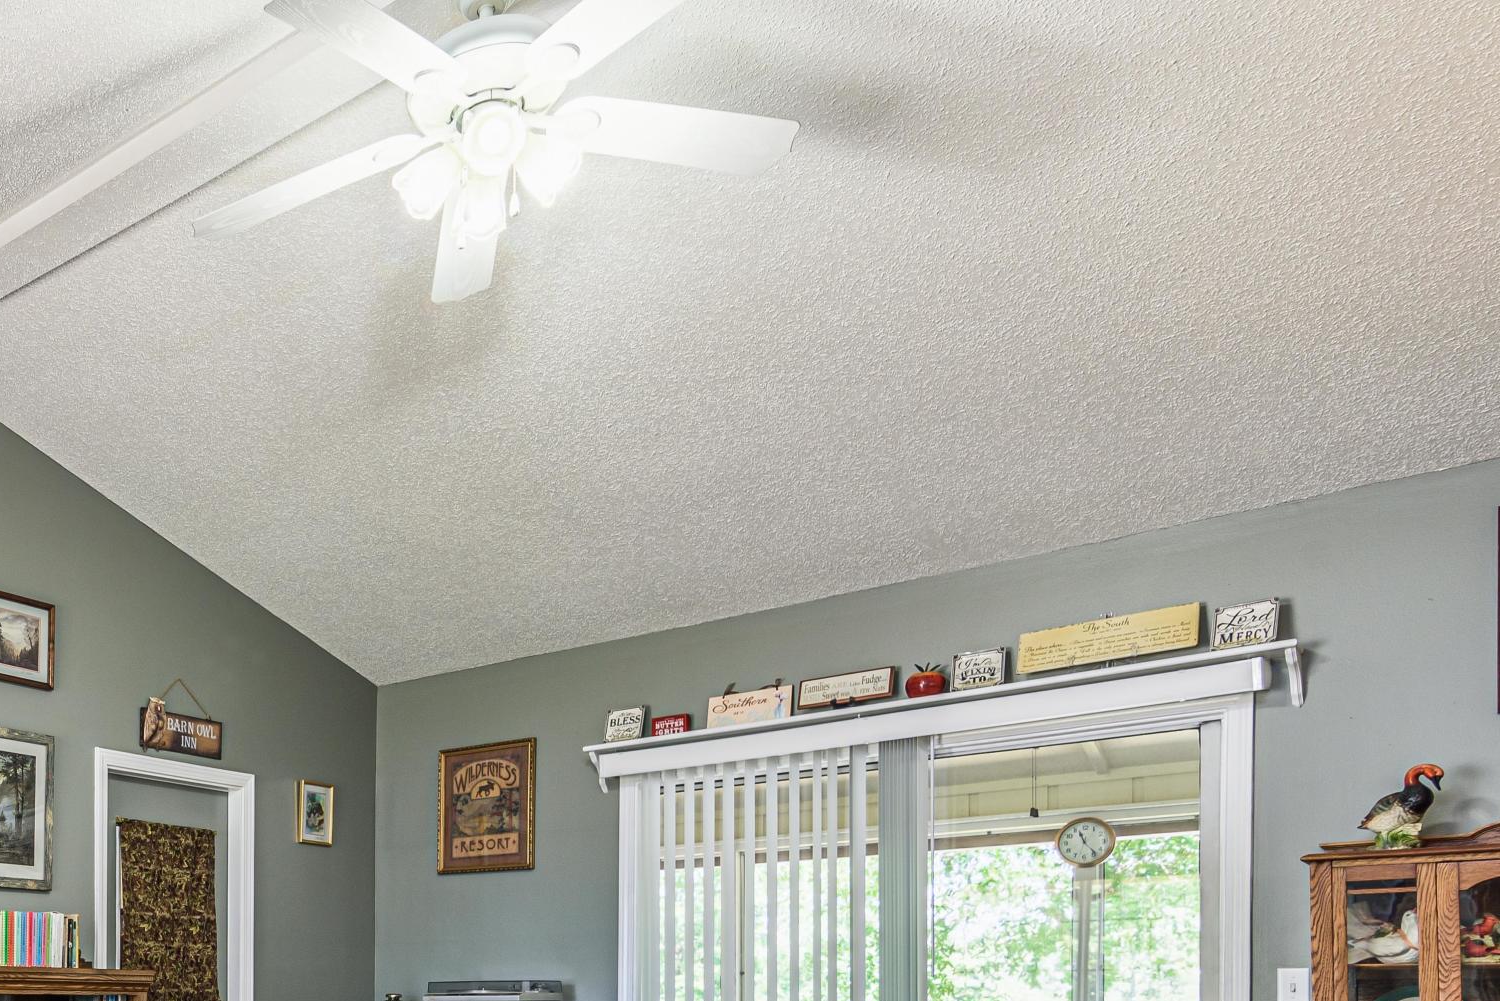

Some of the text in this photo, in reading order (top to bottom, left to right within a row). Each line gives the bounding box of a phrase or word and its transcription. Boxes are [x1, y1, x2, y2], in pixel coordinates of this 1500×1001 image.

[1082, 622, 1100, 633] The
[1104, 617, 1130, 628] South
[1217, 607, 1275, 630] Lord
[1219, 625, 1271, 645] MERCY
[803, 681, 830, 695] Families
[712, 695, 767, 714] Southern
[167, 717, 217, 739] BARN OWL
[609, 714, 641, 728] BLESS
[181, 735, 197, 750] INN
[454, 761, 517, 793] WILDERNESS
[460, 837, 511, 853] RESORT
